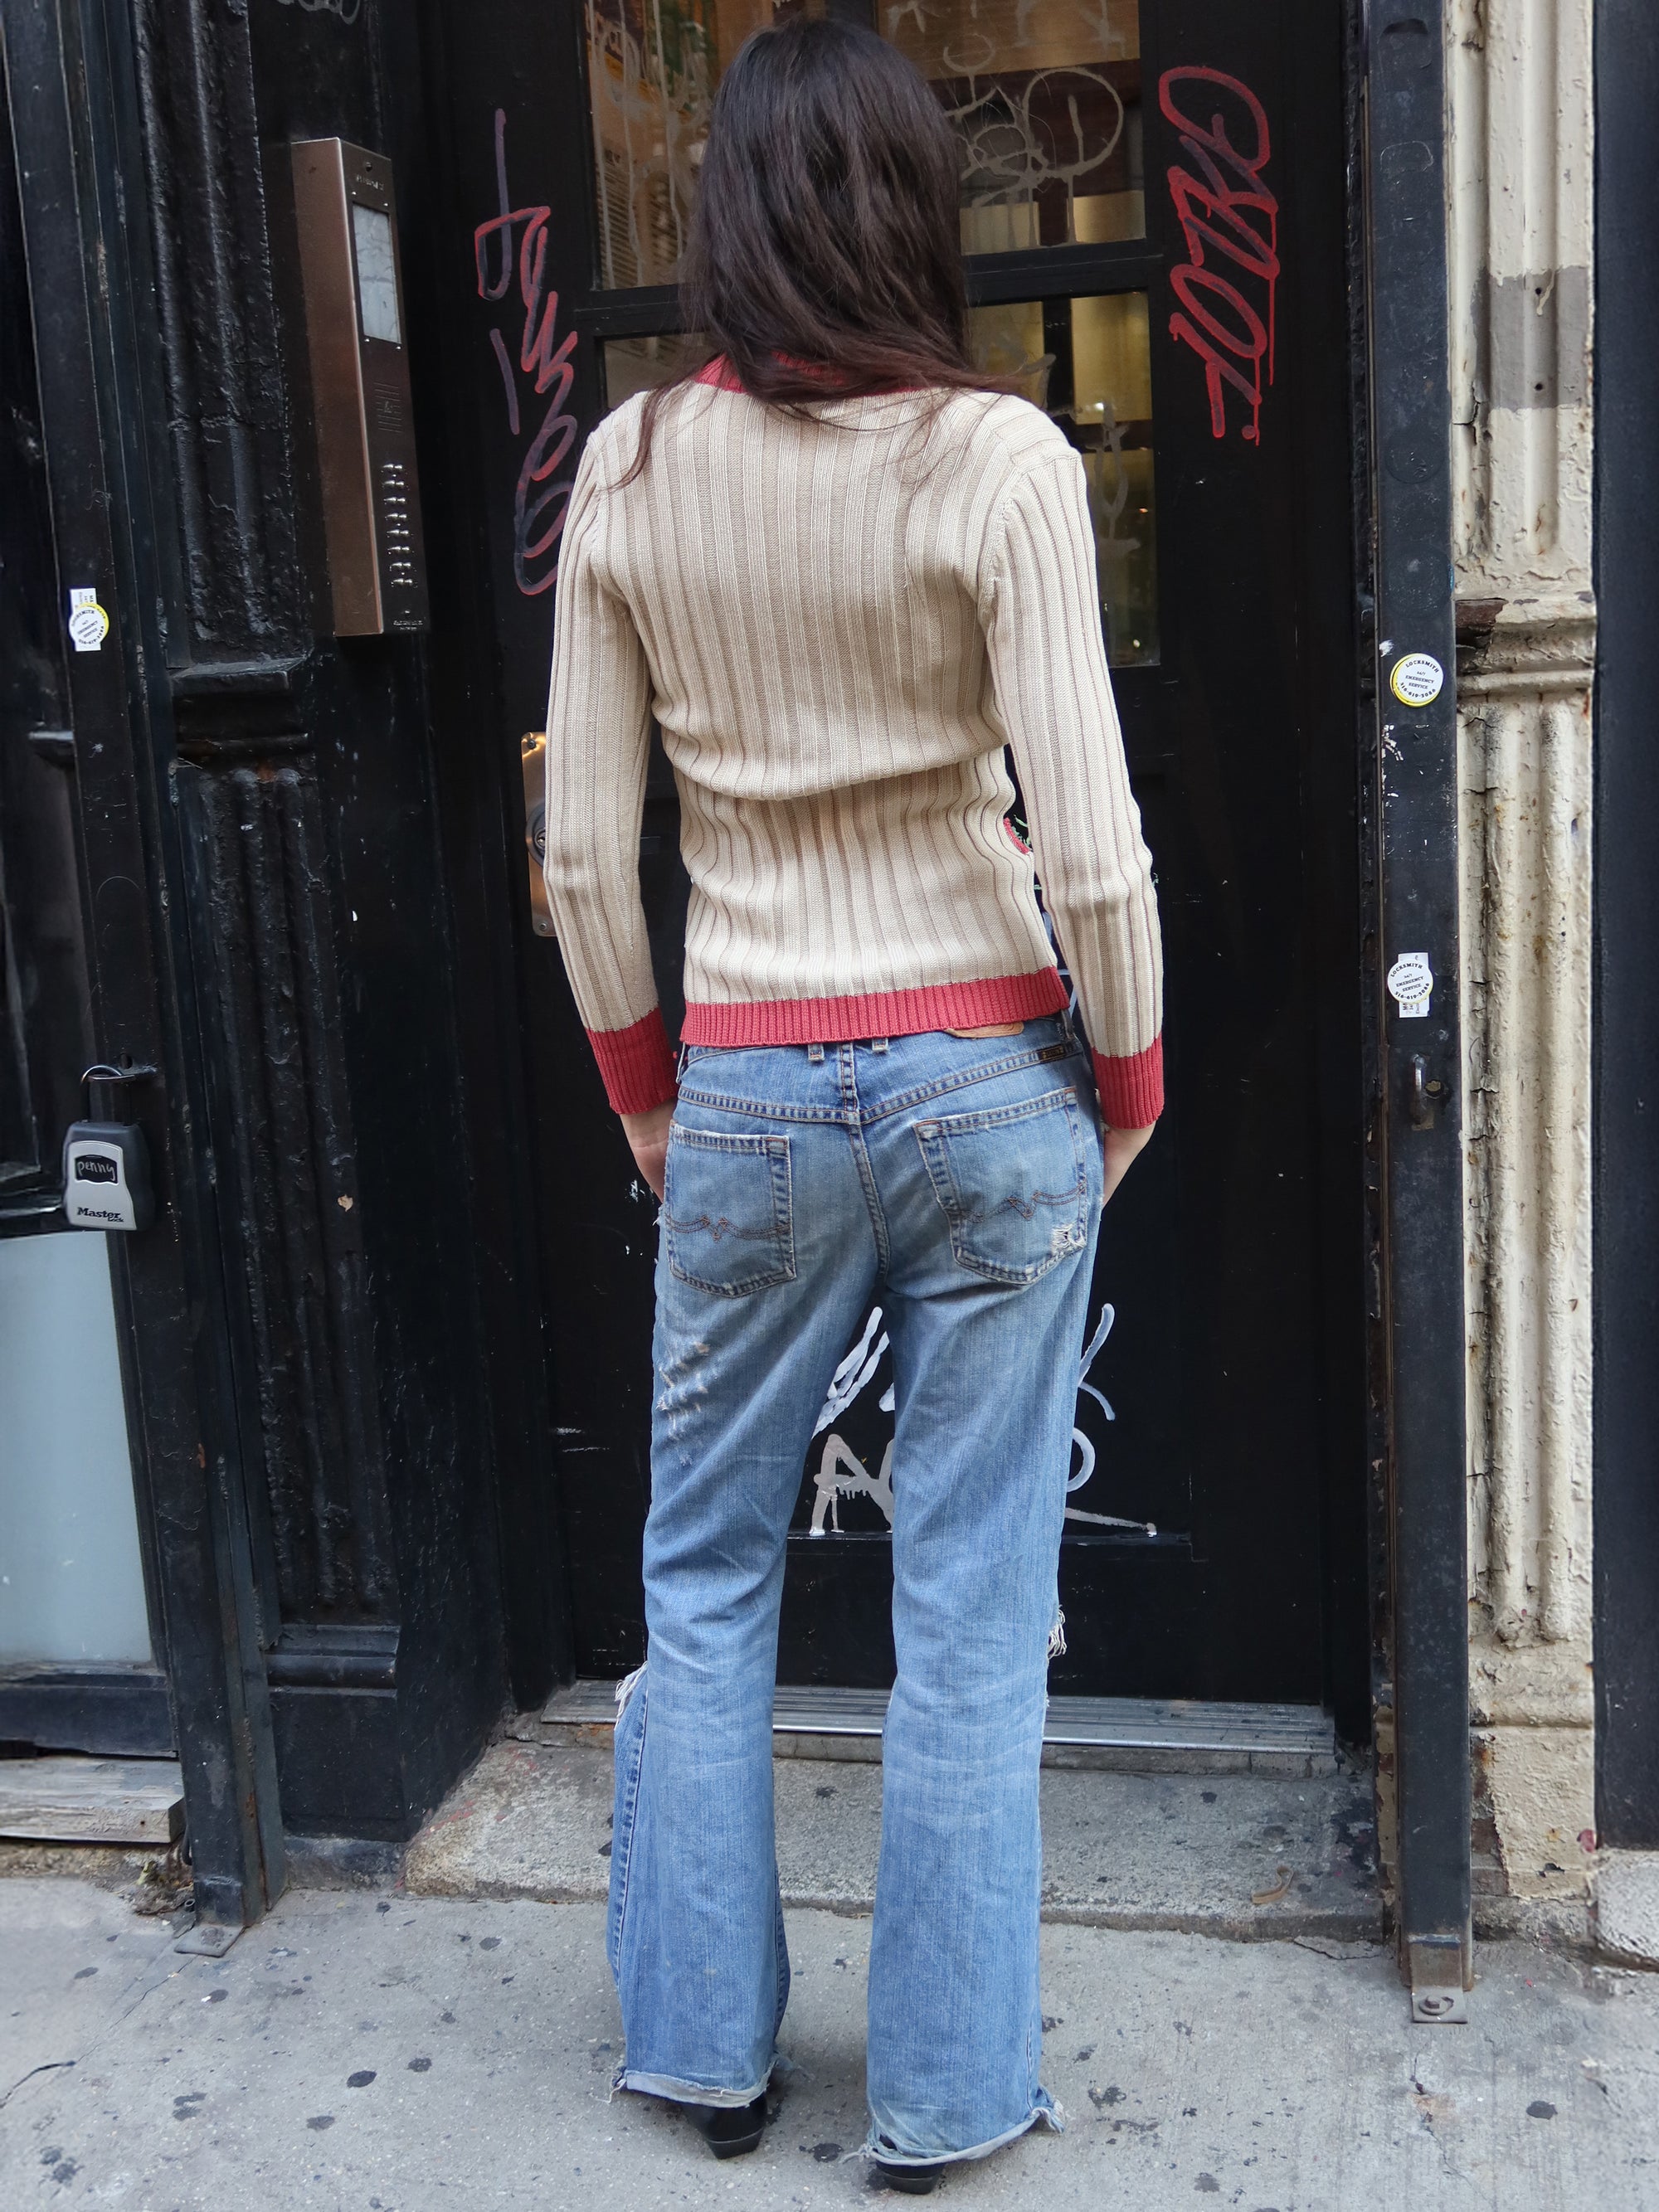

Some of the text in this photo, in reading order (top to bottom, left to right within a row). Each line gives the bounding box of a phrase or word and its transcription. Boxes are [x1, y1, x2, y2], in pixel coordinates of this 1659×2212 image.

[1405, 660, 1439, 673] LOCKSMITH
[1405, 675, 1434, 683] EMERGENCY
[1390, 963, 1423, 977] LOCKSMITH
[1396, 976, 1424, 987] EMERGENCY
[1402, 984, 1422, 992] SERVICE
[76, 1161, 116, 1182] penny
[77, 1207, 121, 1219] Master
